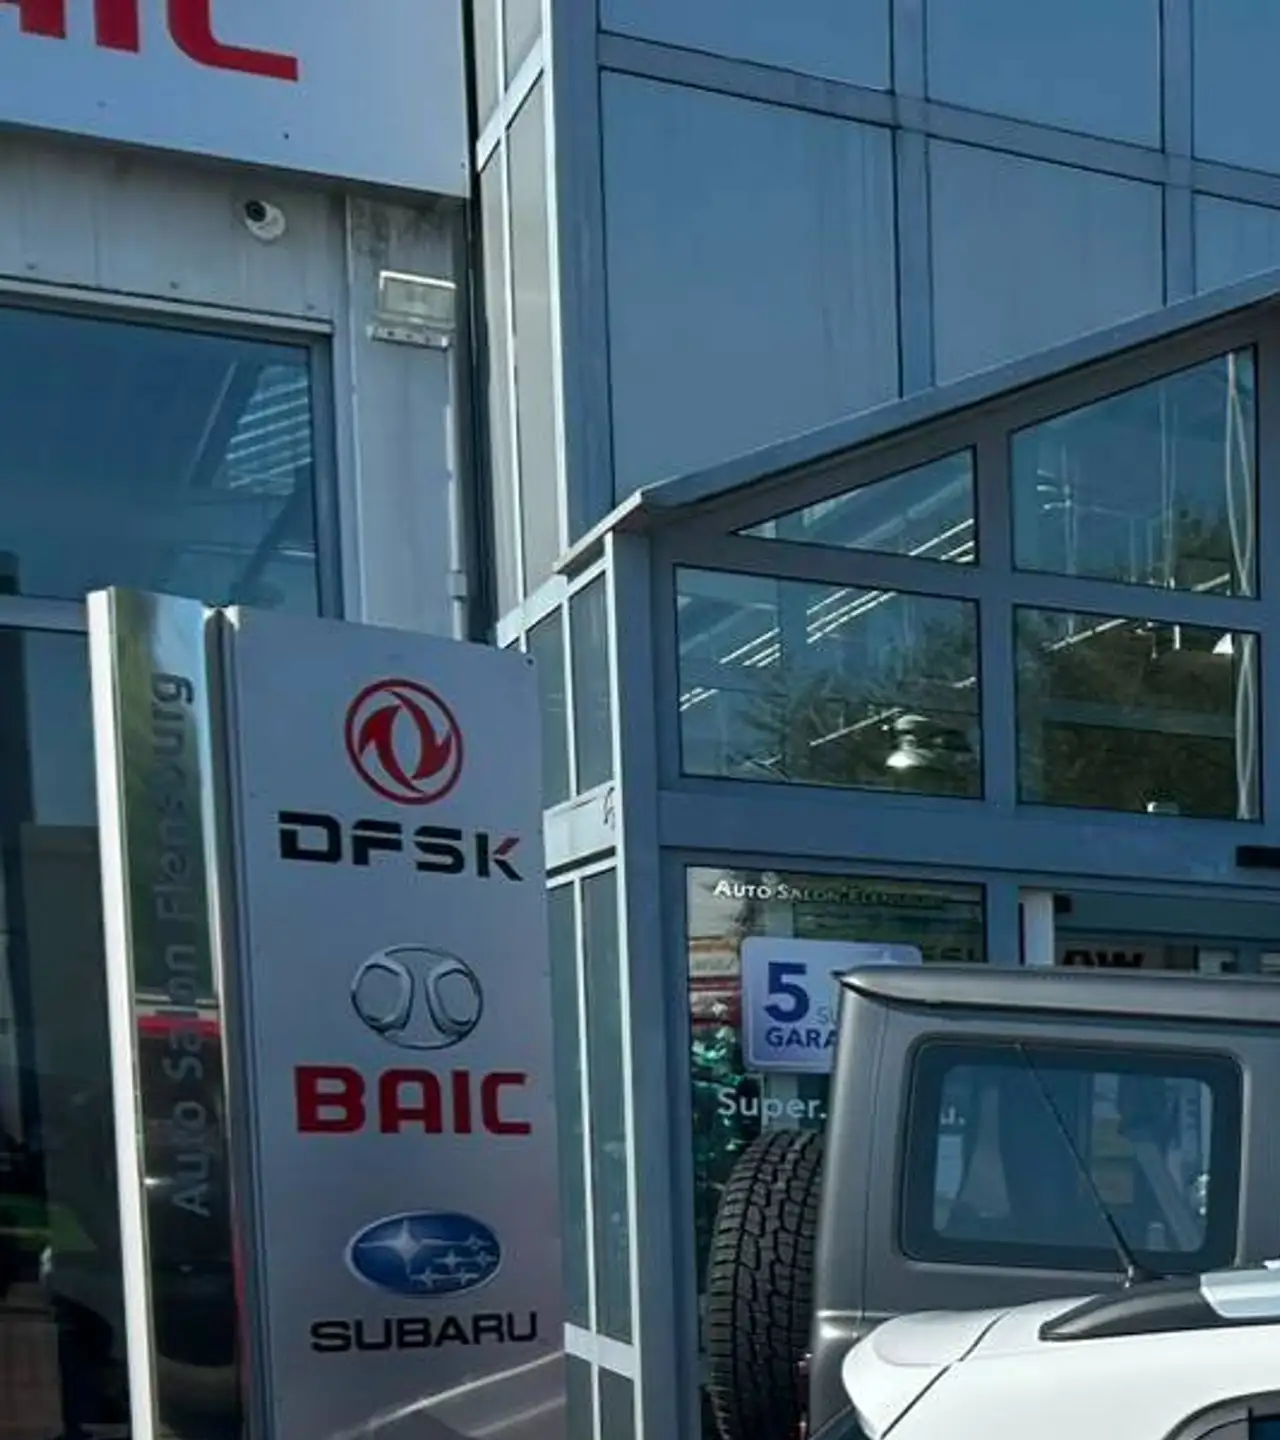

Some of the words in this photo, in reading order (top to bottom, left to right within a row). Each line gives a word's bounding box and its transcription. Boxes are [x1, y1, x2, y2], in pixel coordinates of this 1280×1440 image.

[277, 810, 523, 881] DFSK
[713, 880, 772, 899] AUTO
[764, 962, 810, 1022] 5
[293, 1066, 532, 1134] BAIC
[717, 1088, 827, 1129] Super.
[171, 1101, 210, 1217] Auto
[311, 1313, 537, 1353] SUBARU
